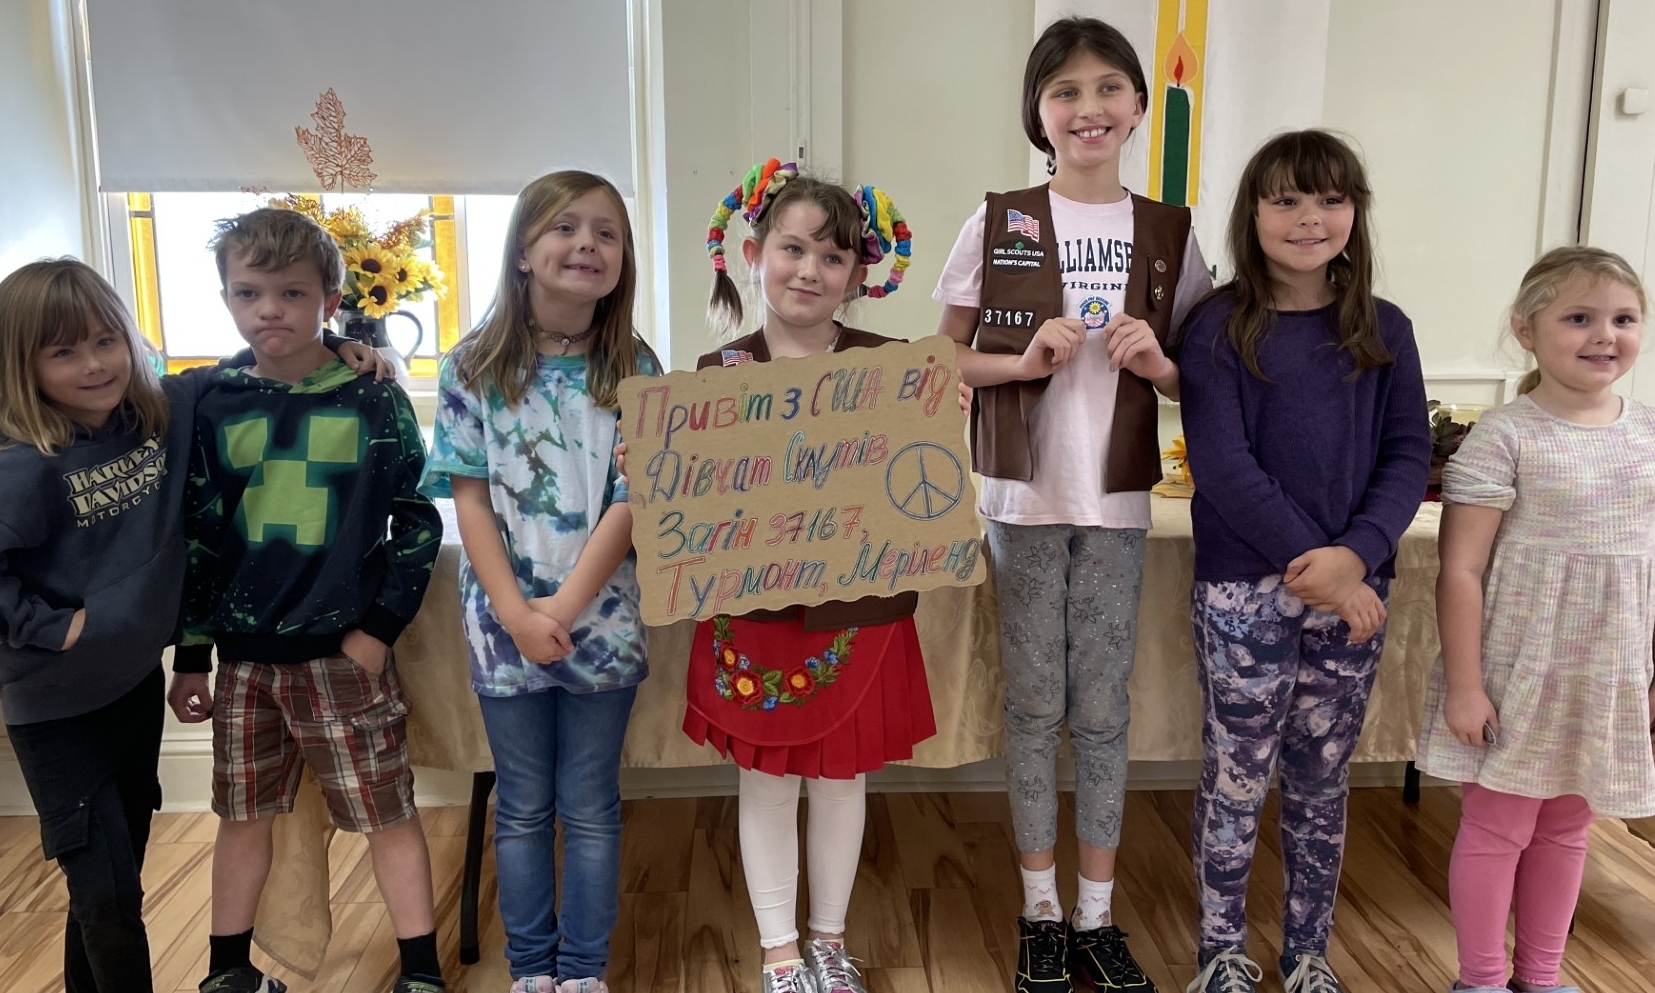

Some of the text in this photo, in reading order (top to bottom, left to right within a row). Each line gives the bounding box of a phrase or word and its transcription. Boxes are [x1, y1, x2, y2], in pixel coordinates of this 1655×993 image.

[1006, 249, 1031, 257] SCOUTS
[1031, 250, 1045, 258] USA
[1017, 260, 1042, 268] CAPITAL
[1057, 237, 1133, 273] LIAMSB
[984, 309, 1034, 327] 37167
[635, 384, 772, 450] Привіт
[810, 364, 885, 418] США
[646, 449, 772, 504] Дівчат
[658, 505, 869, 559] Загін 37167,
[657, 538, 980, 619] Турмонт, Меріленд
